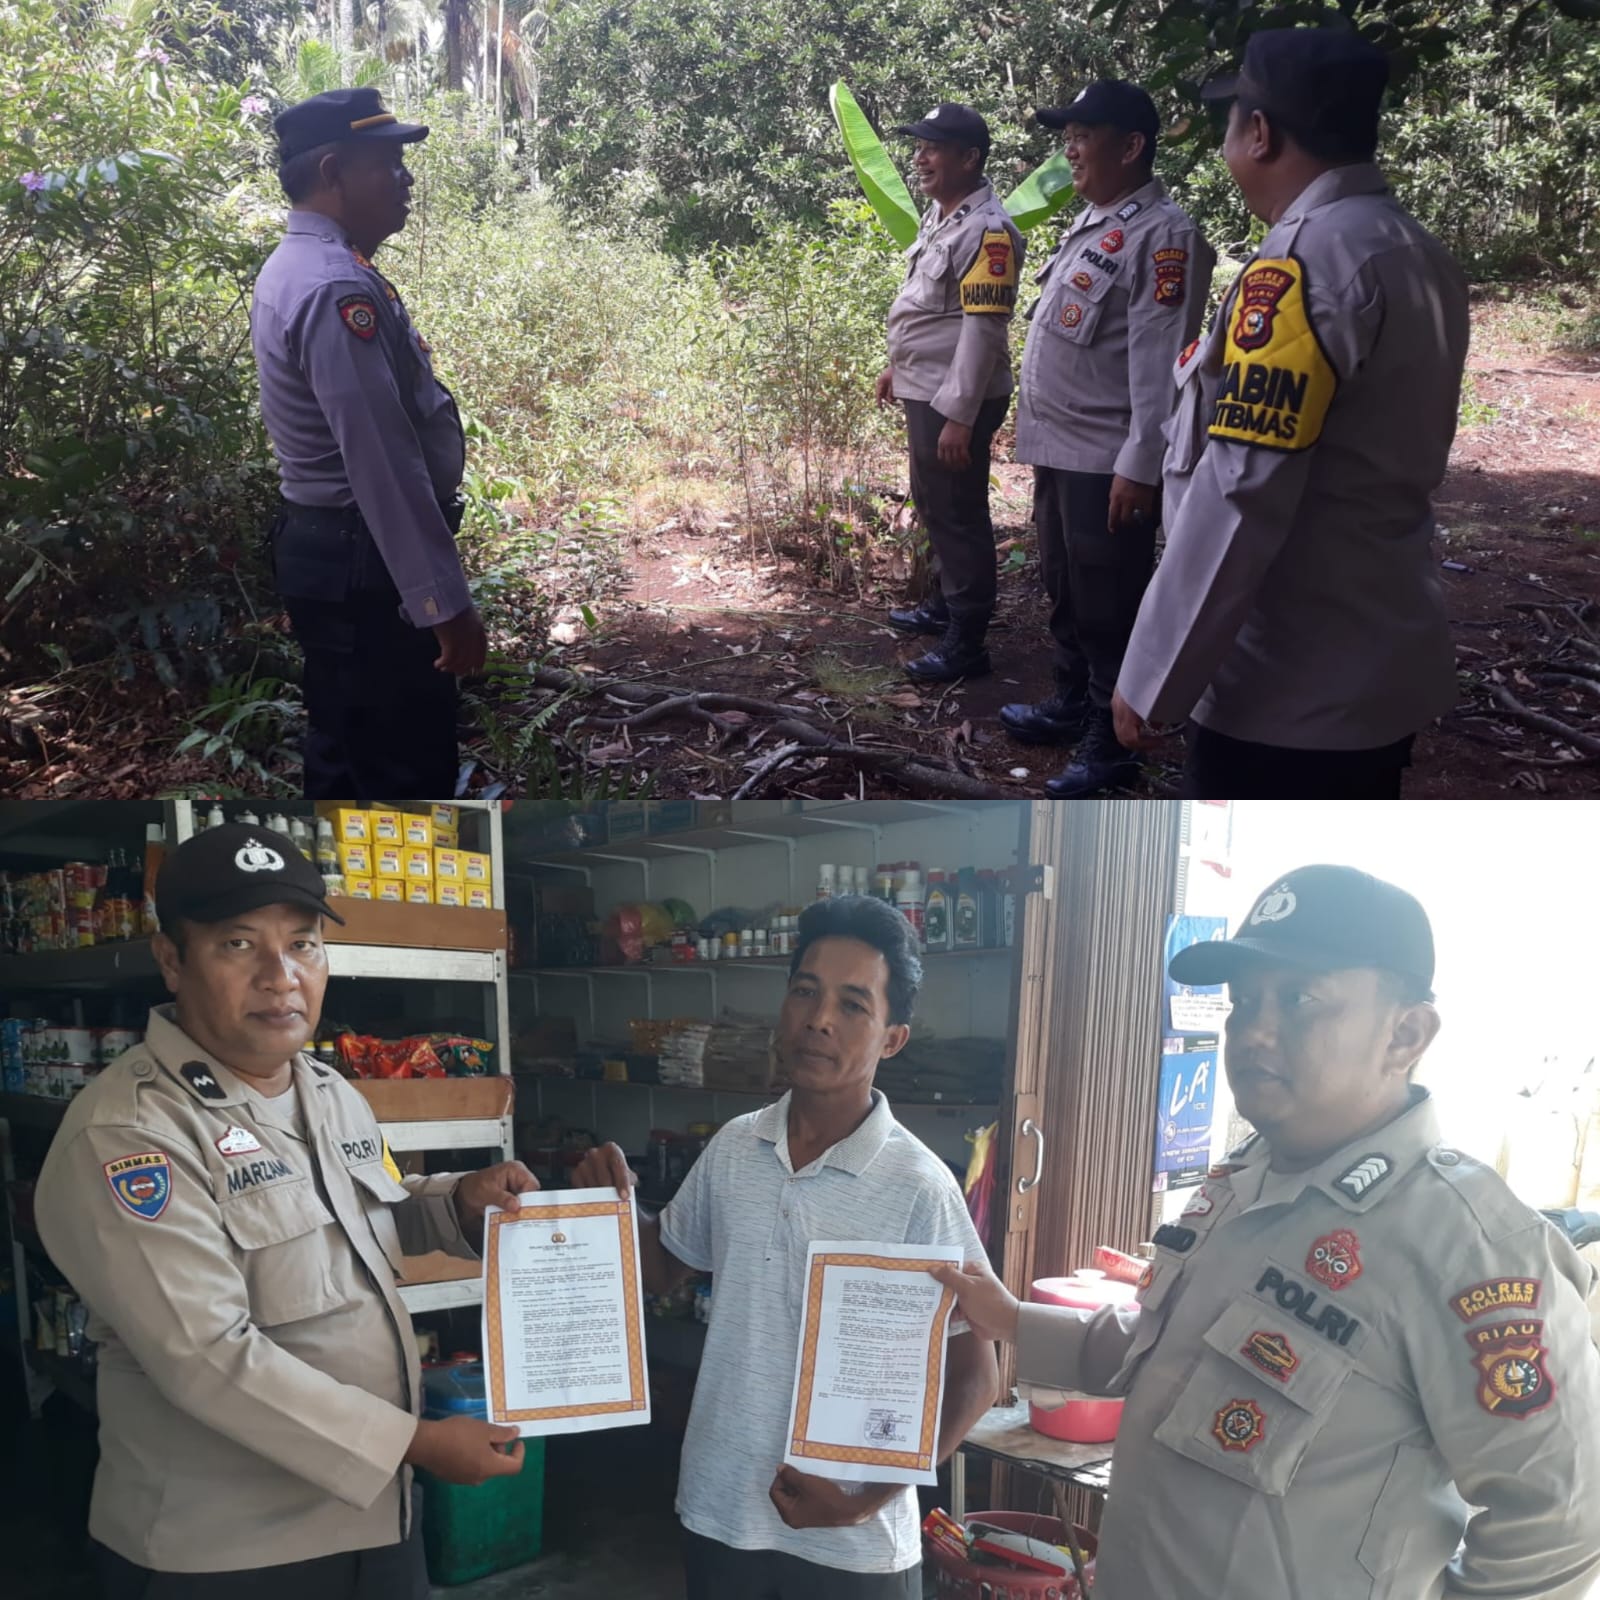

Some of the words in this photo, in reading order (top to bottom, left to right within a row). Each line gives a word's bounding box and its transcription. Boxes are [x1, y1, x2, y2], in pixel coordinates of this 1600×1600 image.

[1080, 248, 1118, 275] POLRI
[341, 1138, 378, 1162] PORI
[109, 1156, 162, 1172] BINMAS
[1255, 1266, 1360, 1346] POLRI
[1459, 1282, 1535, 1310] POLRES
[1464, 1293, 1533, 1317] PELALAWAN
[1477, 1324, 1535, 1343] RIAU
